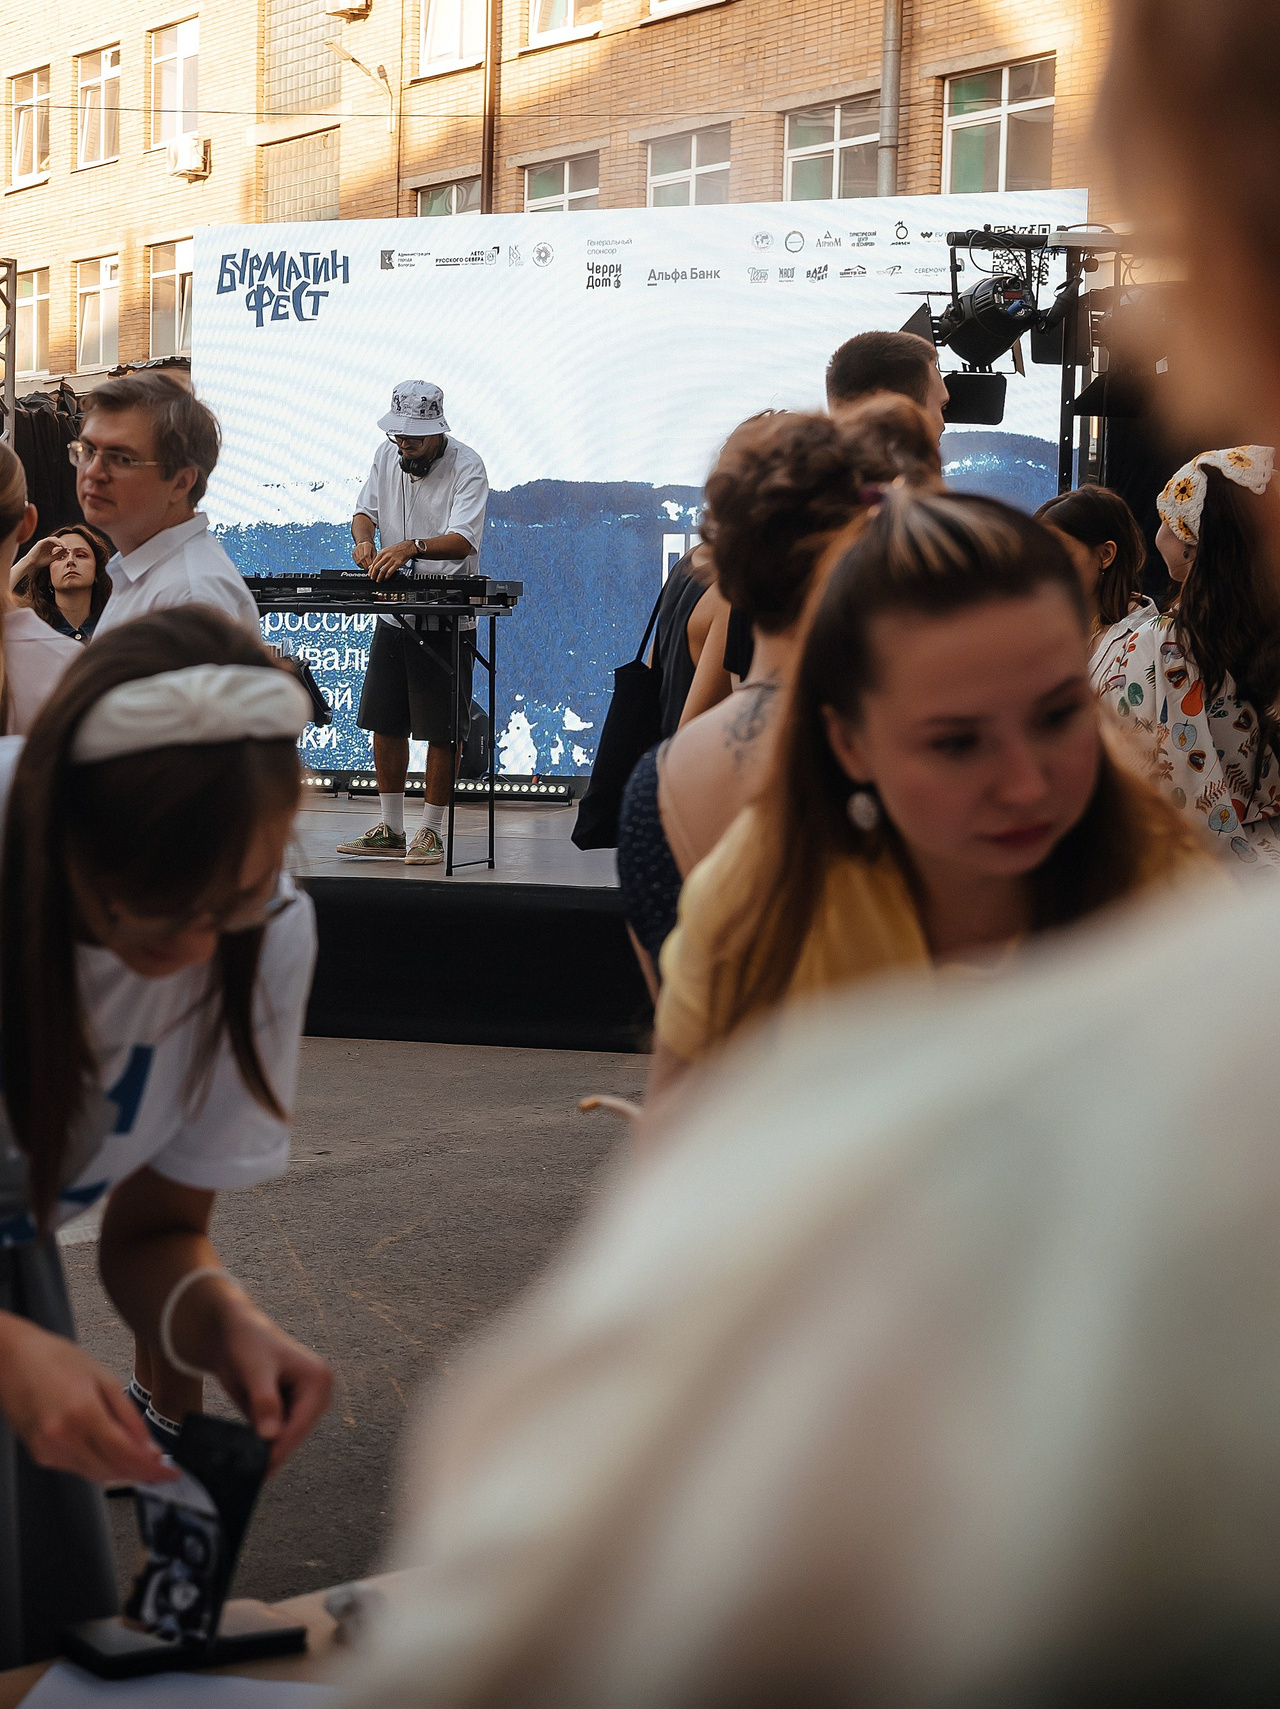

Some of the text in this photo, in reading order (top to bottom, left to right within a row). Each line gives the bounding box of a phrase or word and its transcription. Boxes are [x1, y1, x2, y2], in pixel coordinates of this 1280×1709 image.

[587, 238, 633, 247] Генеральный
[587, 247, 617, 255] спонсор
[586, 262, 622, 277] Черри
[647, 267, 721, 283] Альфа Банк
[586, 275, 611, 290] Дом
[245, 280, 329, 328] ФЕСТ
